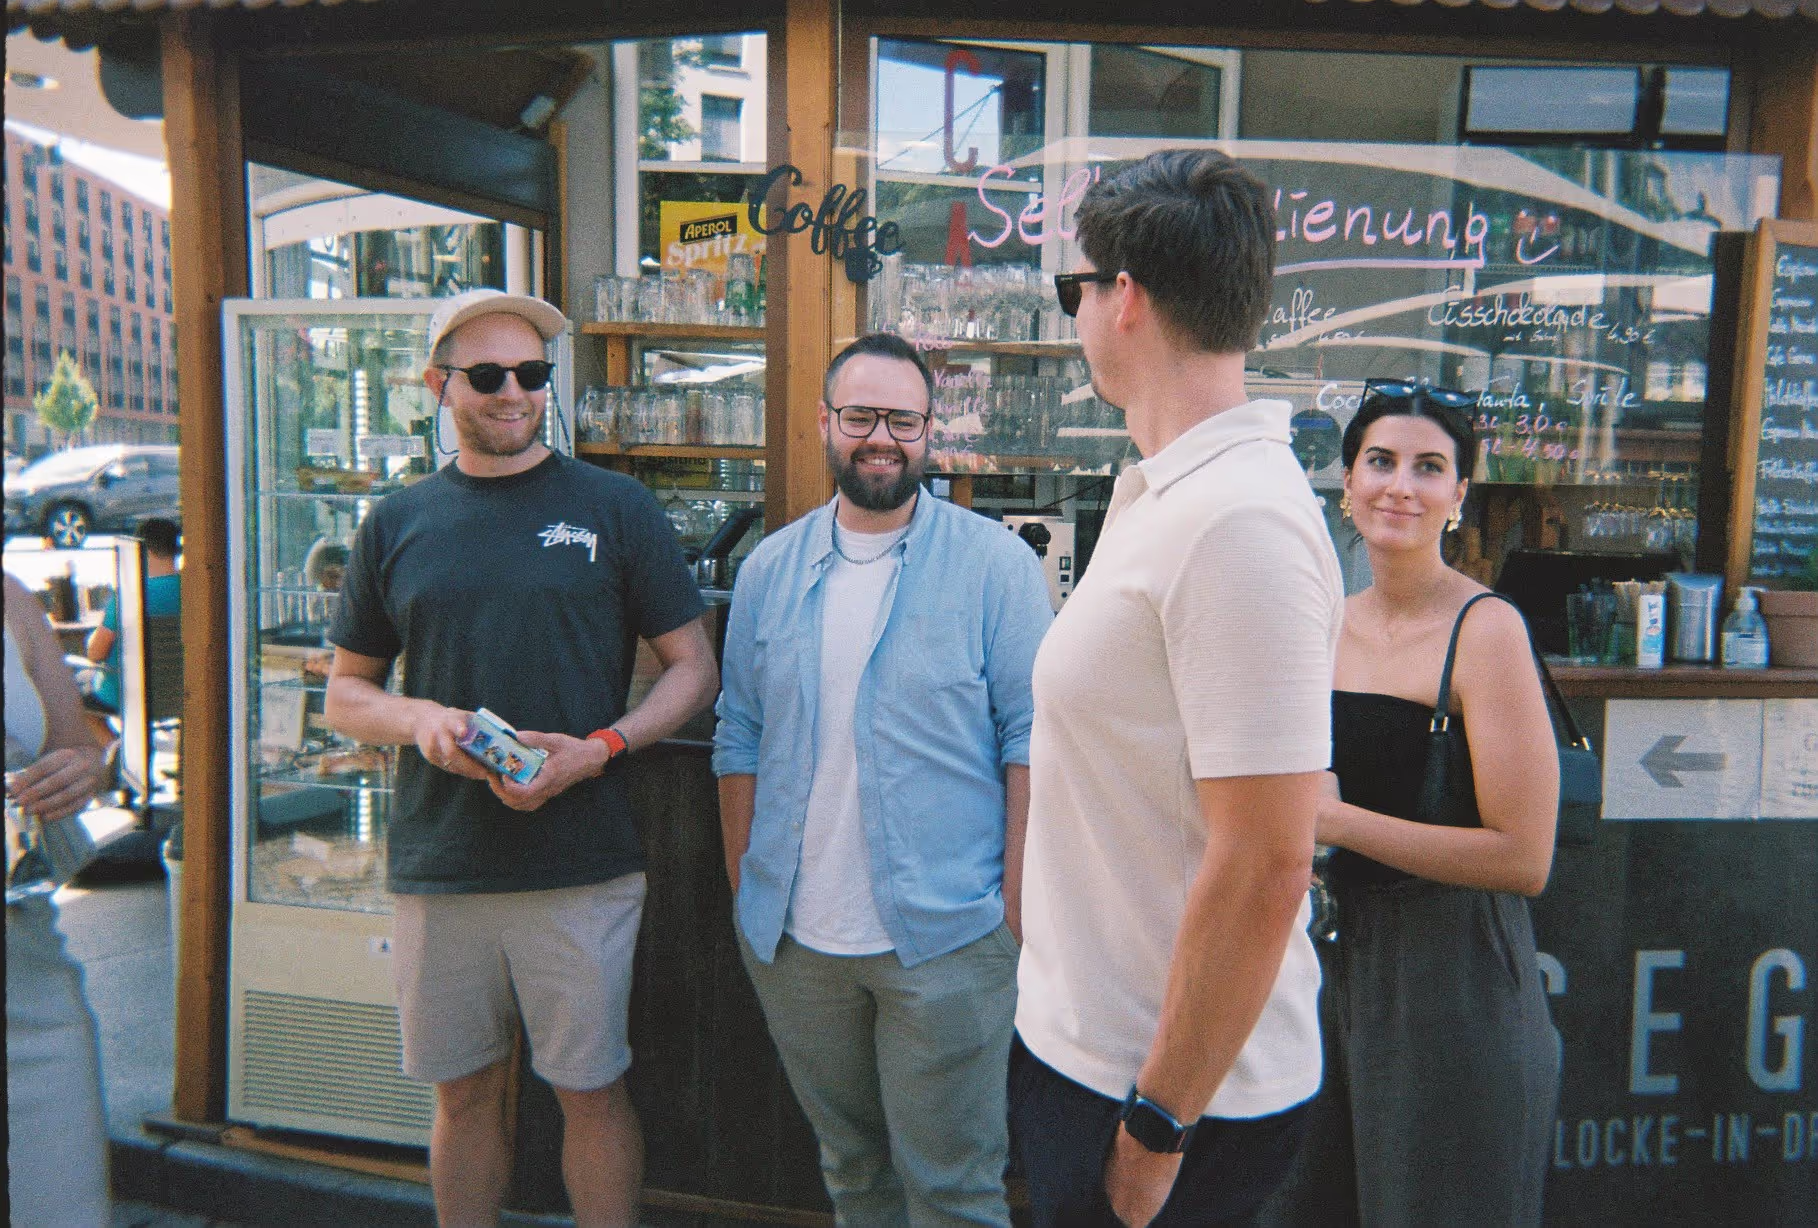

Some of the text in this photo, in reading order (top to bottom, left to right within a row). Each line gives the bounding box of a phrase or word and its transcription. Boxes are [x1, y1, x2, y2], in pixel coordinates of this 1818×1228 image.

[684, 219, 732, 241] APEROL
[748, 163, 907, 260] Coffee
[666, 232, 748, 268] Spritz
[1263, 286, 1337, 333] affee
